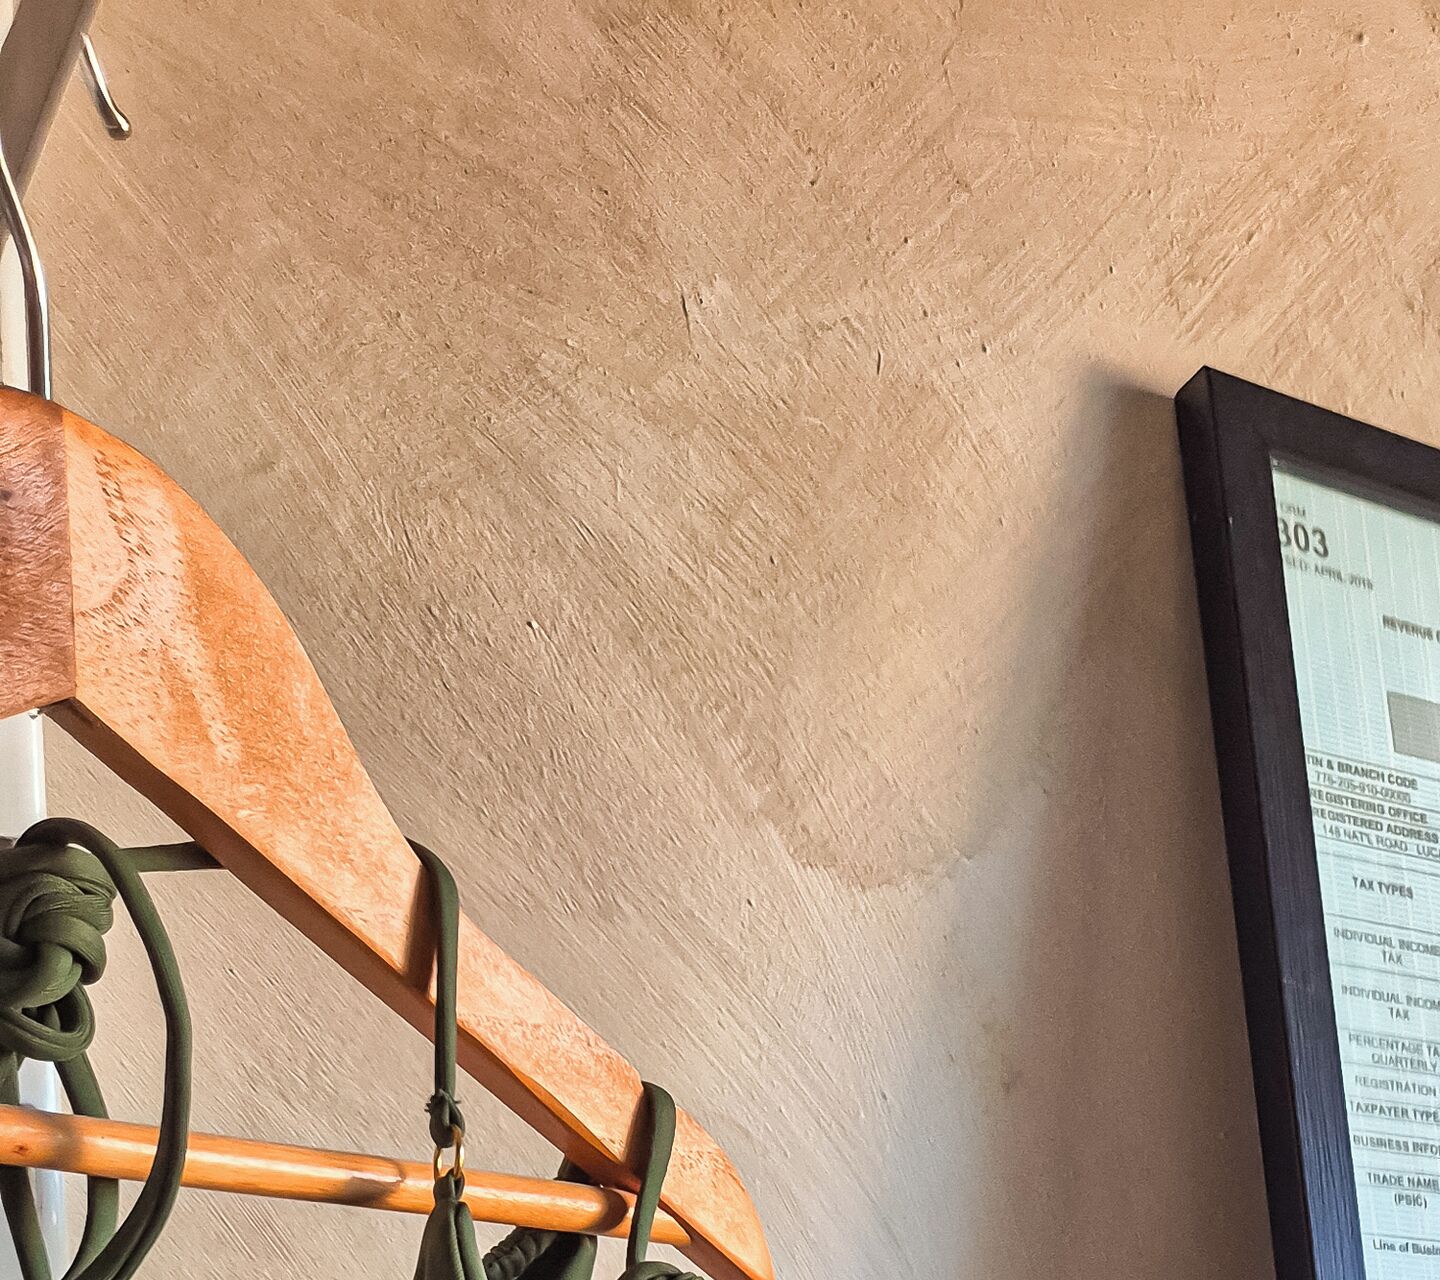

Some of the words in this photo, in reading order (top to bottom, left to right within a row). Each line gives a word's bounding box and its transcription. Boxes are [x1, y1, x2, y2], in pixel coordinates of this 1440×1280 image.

[1337, 762, 1385, 783] BRANCH
[1387, 773, 1419, 791] CODE
[1388, 804, 1429, 824] OFFICE
[1376, 834, 1409, 852] ROAD
[1386, 823, 1440, 845] ADDRESS
[1352, 876, 1375, 891] TAX
[1377, 881, 1413, 901] TYPES
[1333, 926, 1394, 950] INDIVIDUAL
[1382, 950, 1404, 966] TAX
[1341, 983, 1402, 1006] INDIVIDUAL
[1389, 1005, 1411, 1022] TAX
[1349, 1033, 1424, 1058] PERCENTAGE
[1371, 1052, 1438, 1073] QUARTERLY
[1355, 1074, 1436, 1098] REGISTRATION
[1349, 1101, 1409, 1120] TAXPAYER
[1353, 1133, 1410, 1153] BUSINESS
[1367, 1171, 1404, 1186] TRADE
[1407, 1177, 1440, 1191] NAME
[1373, 1239, 1396, 1252] Line
[1399, 1242, 1410, 1253] of
